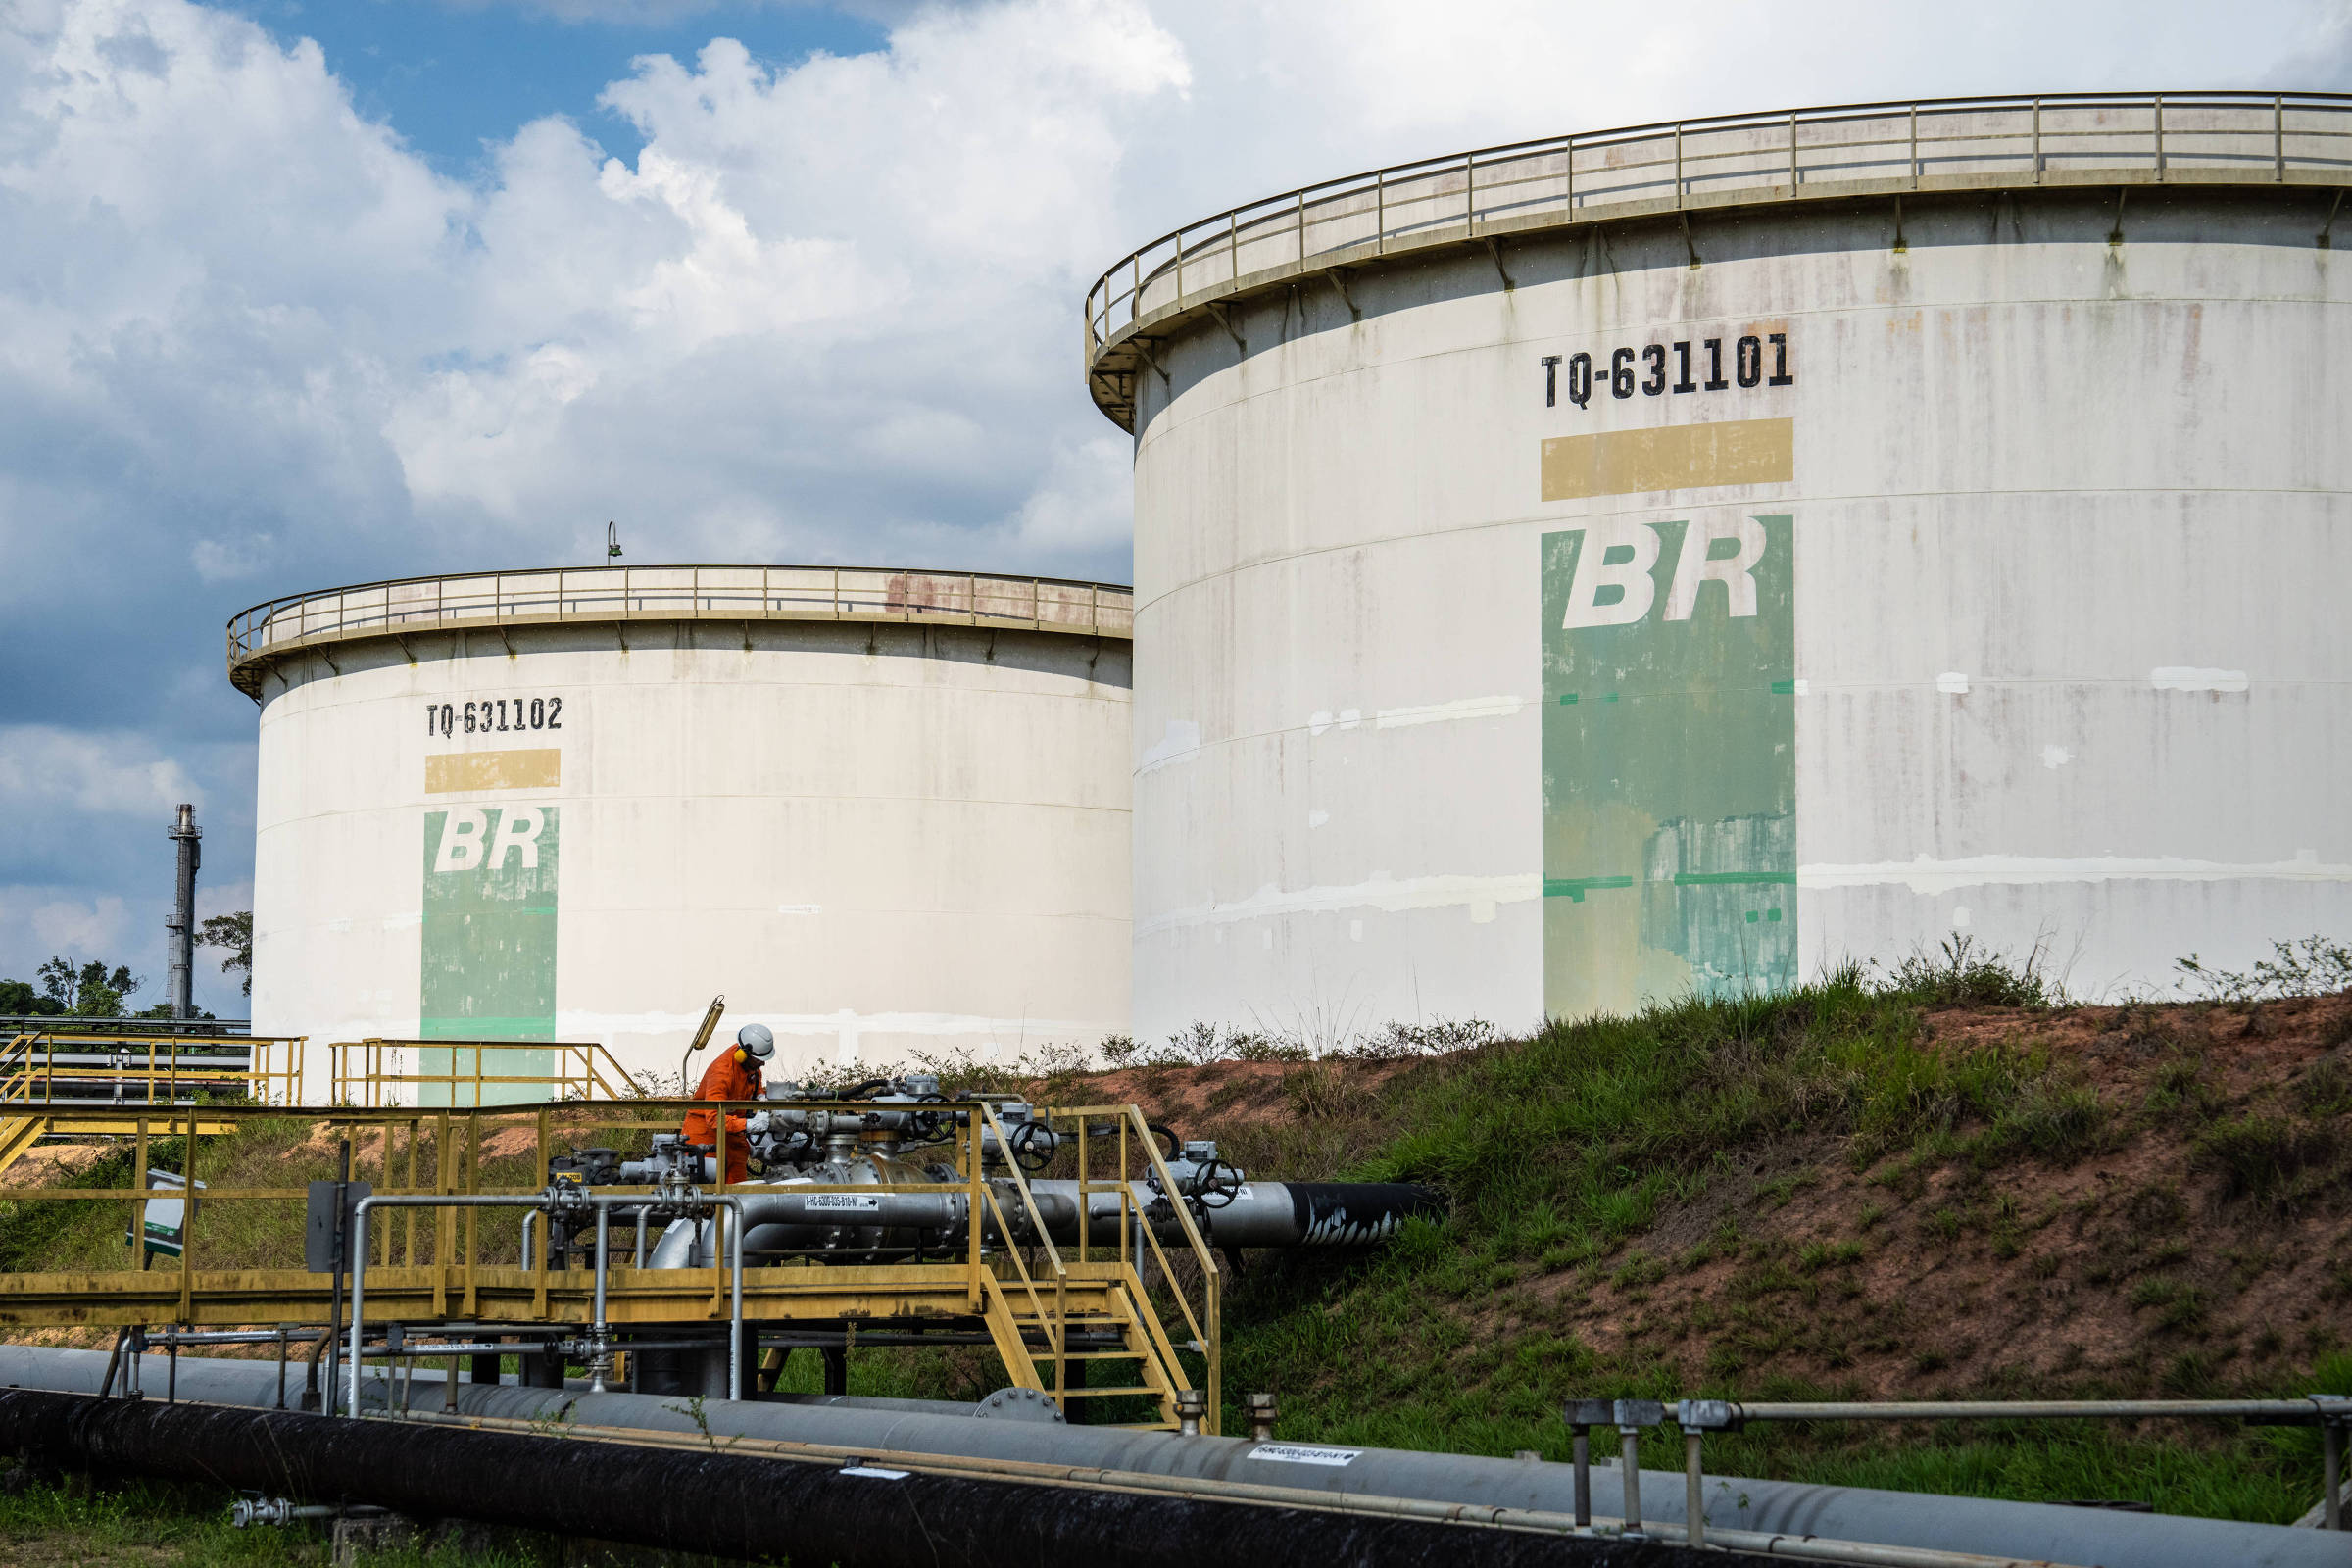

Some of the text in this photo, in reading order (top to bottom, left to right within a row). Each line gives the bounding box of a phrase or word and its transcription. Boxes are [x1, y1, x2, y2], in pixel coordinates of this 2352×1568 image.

[1541, 333, 1793, 410] TQ-631101
[1562, 515, 1767, 629] BR
[426, 697, 563, 739] TQ-631102
[433, 807, 545, 872] BR
